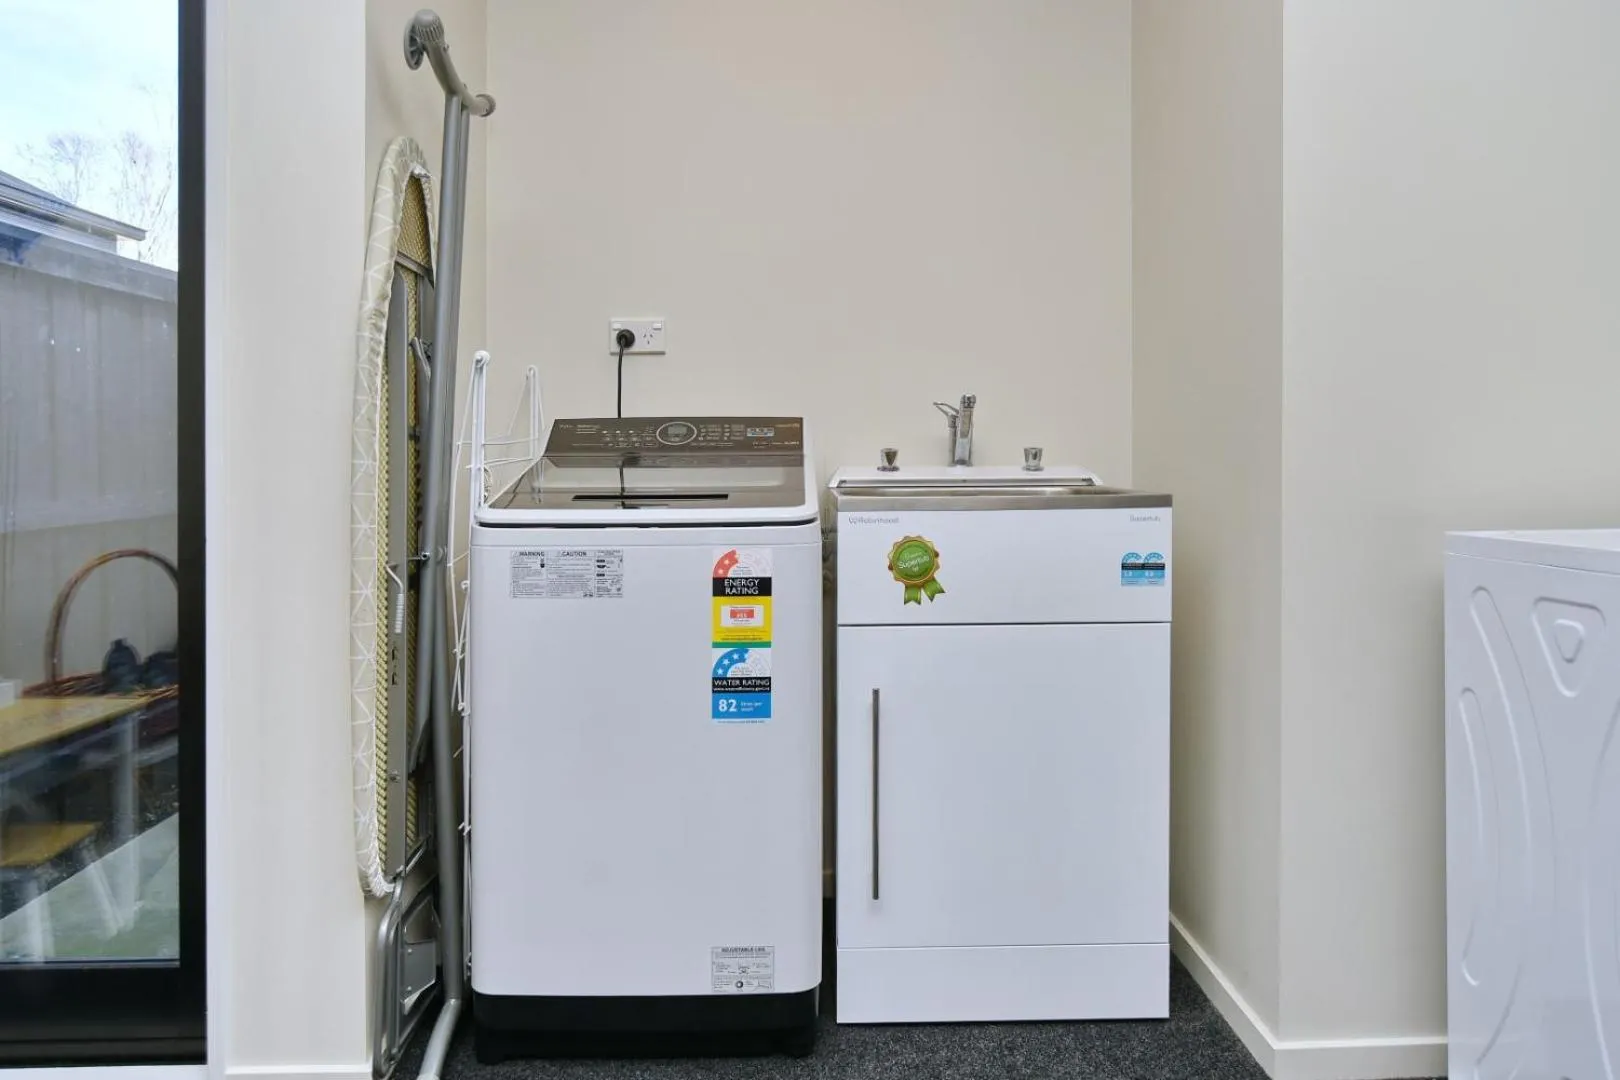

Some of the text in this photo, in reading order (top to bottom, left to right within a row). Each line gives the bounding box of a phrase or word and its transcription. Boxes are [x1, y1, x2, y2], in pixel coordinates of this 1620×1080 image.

[724, 579, 760, 587] ENERGY
[725, 587, 759, 595] RATING
[718, 699, 737, 712] 82
